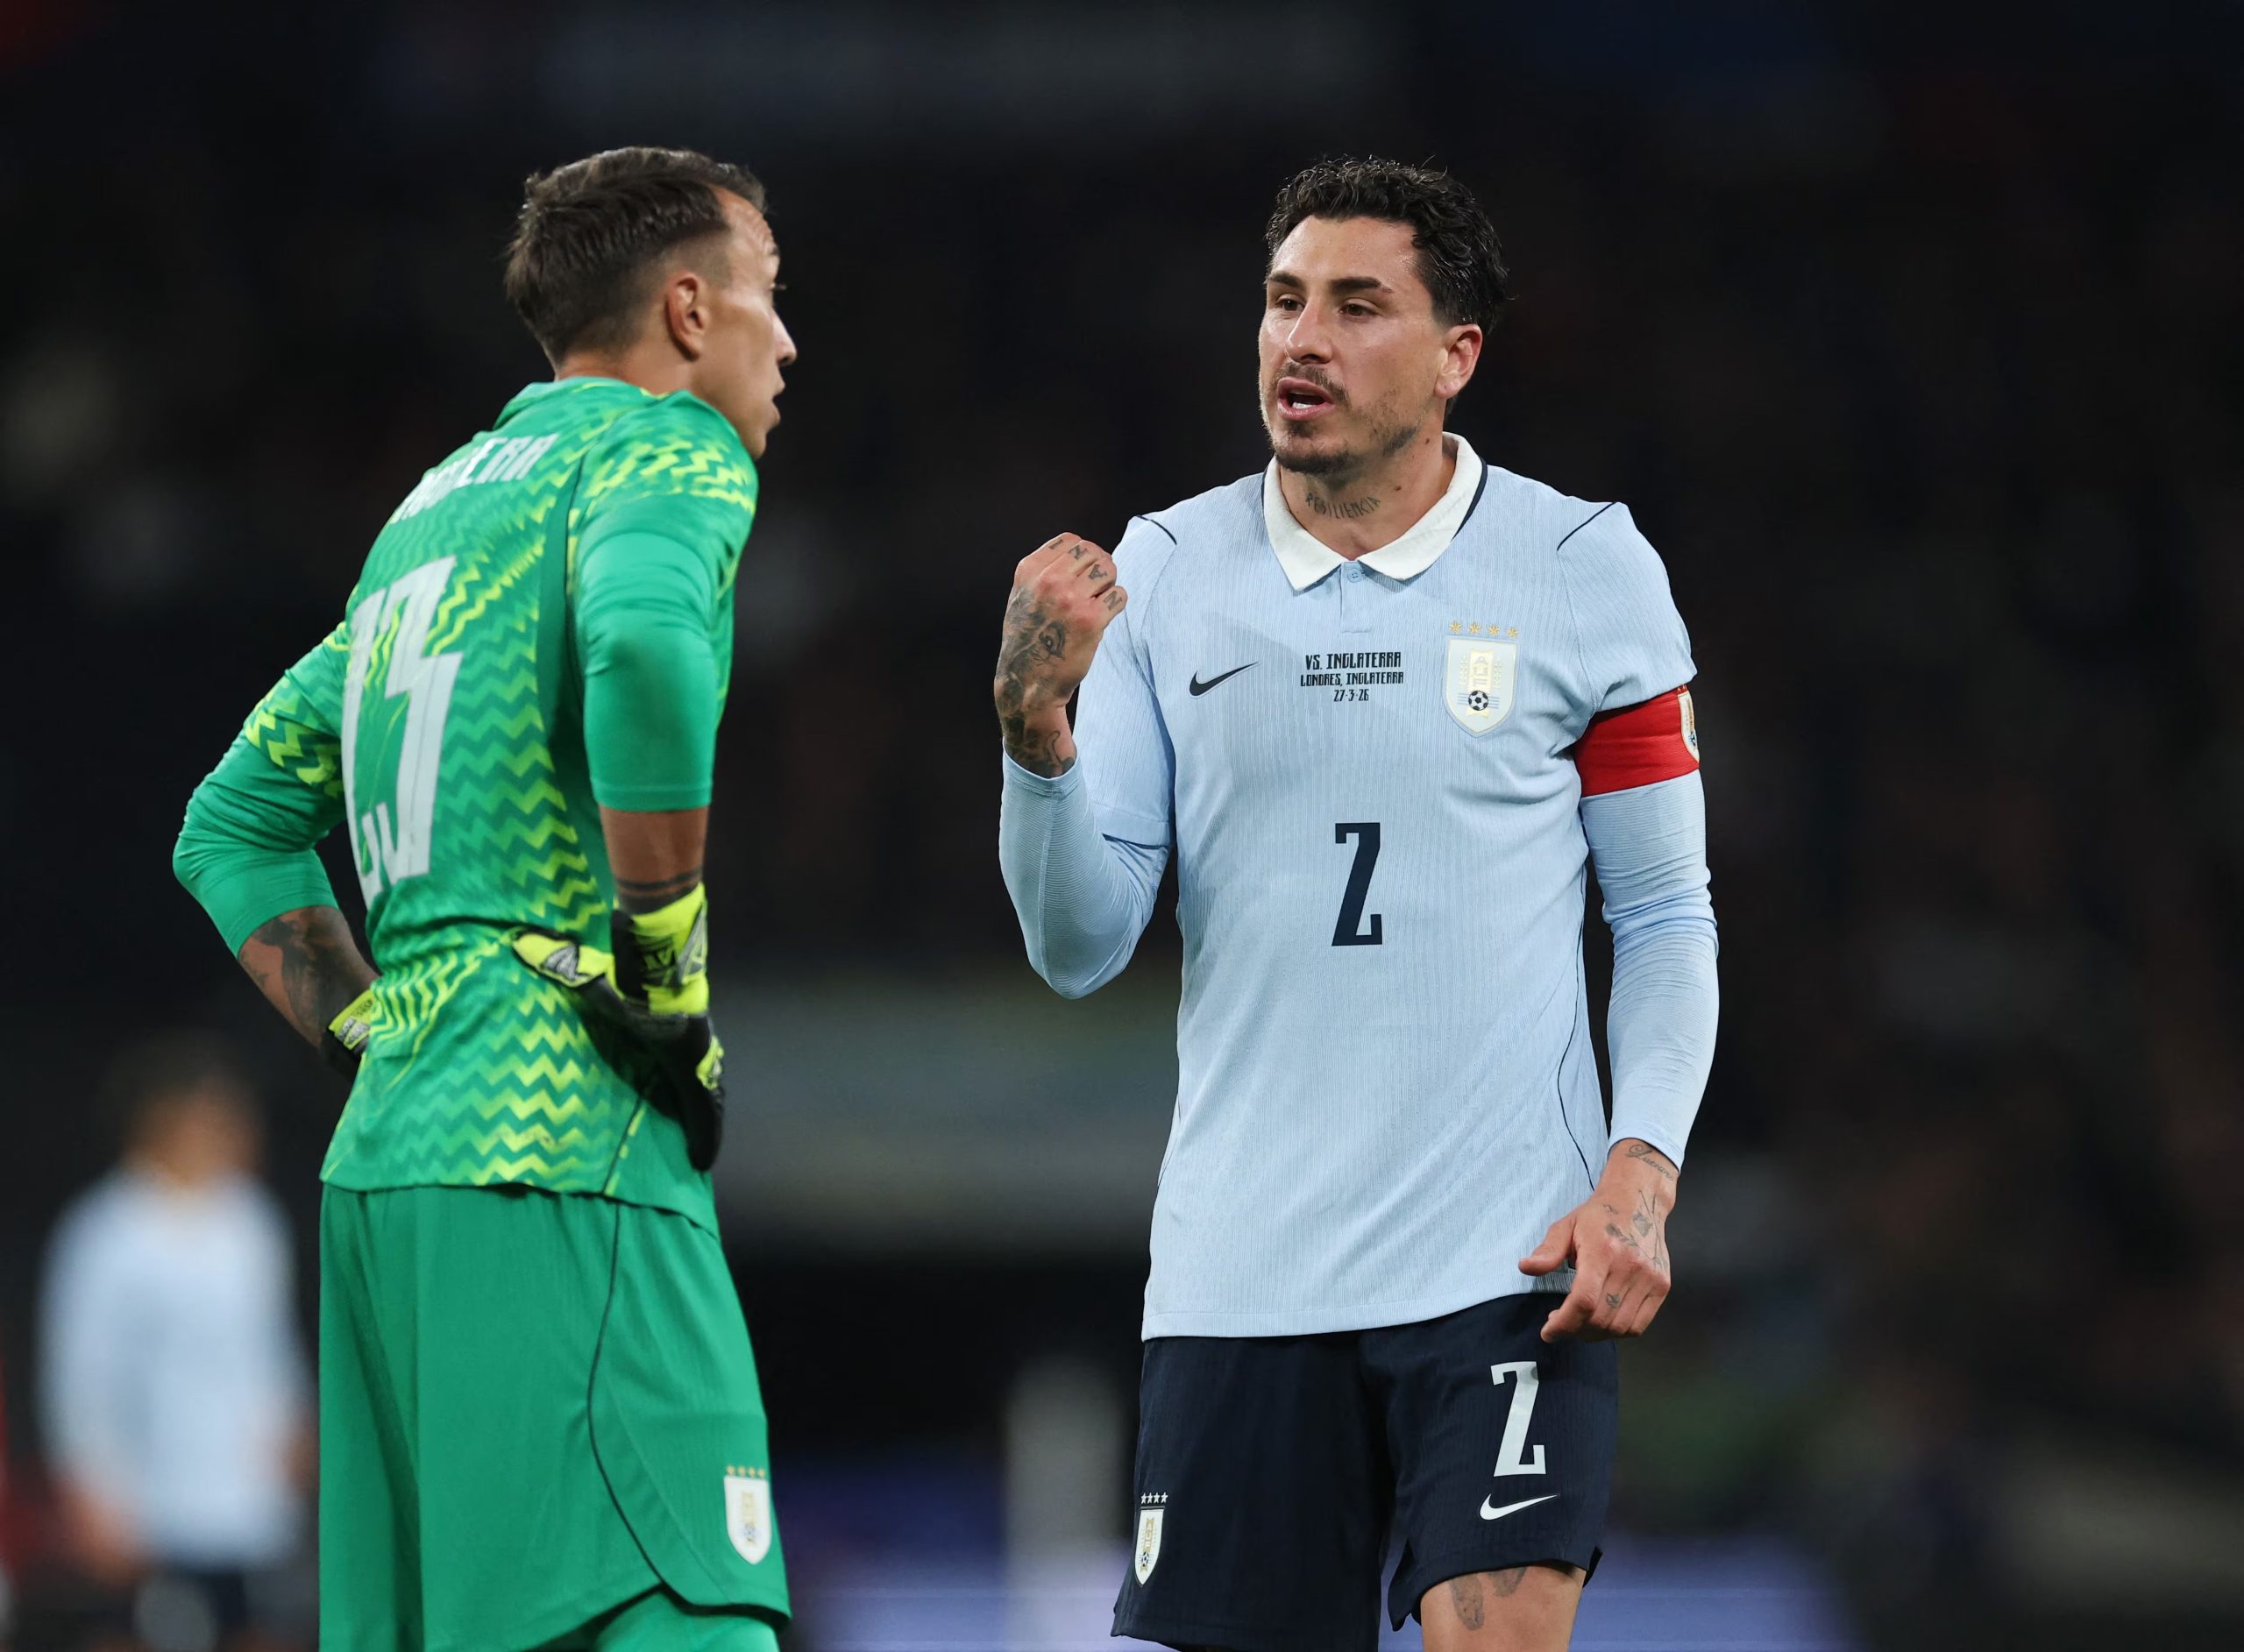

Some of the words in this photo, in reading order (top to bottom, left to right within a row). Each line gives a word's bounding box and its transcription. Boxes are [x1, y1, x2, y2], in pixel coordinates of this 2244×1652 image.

[1300, 673, 1343, 687] LONDRES,
[1346, 671, 1403, 685] INGLATERRA
[1305, 654, 1323, 670] VS.
[1326, 652, 1401, 670] INGLATERRA
[1331, 822, 1382, 947] 2
[1490, 1361, 1546, 1477] 2
